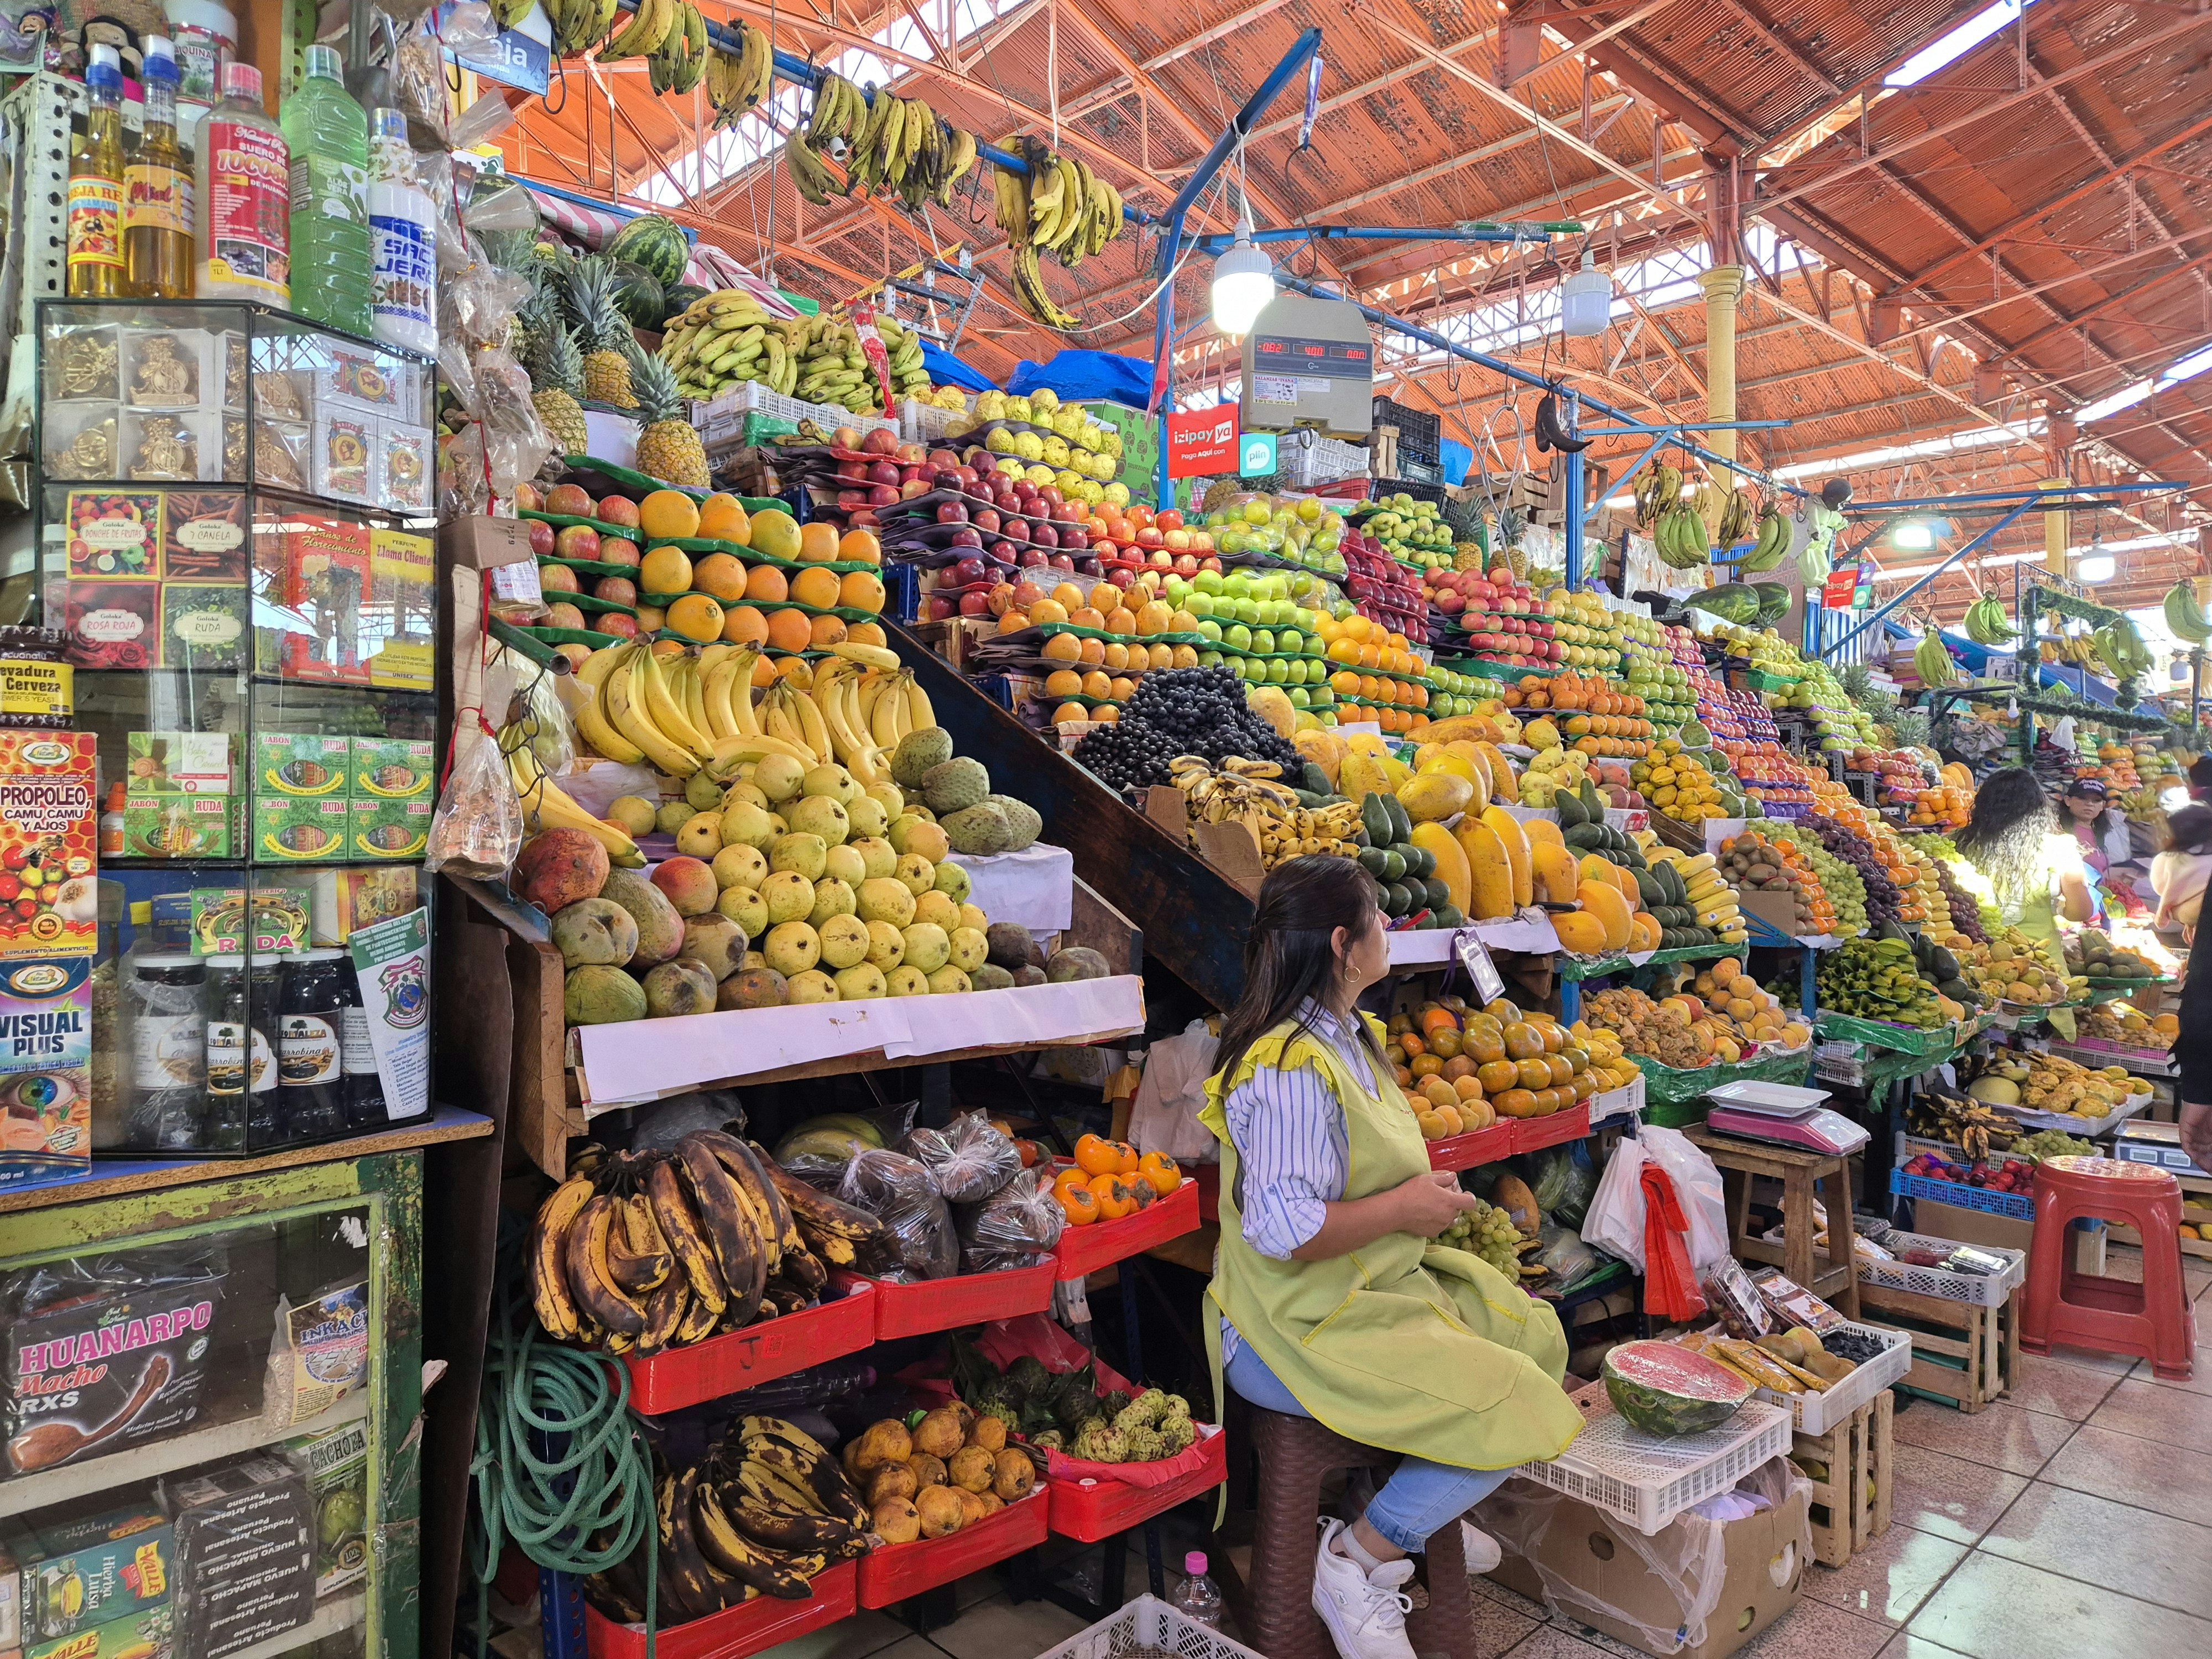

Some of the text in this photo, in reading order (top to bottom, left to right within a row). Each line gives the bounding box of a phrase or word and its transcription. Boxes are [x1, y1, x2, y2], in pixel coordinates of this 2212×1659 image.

[239, 142, 286, 166] SUERO DE
[251, 179, 261, 187] DE
[327, 177, 347, 189] ALOE
[327, 184, 347, 195] VERA
[1175, 425, 1231, 445] izipay ya
[1197, 449, 1213, 457] AQUÍ
[1249, 450, 1266, 463] plin
[112, 529, 119, 538] DE
[121, 529, 142, 538] FRUTAS
[197, 531, 230, 540] CANELA
[346, 535, 357, 543] de
[301, 535, 368, 556] Florecimiento
[393, 539, 418, 549] PERFUME
[404, 549, 431, 566] Cliente
[87, 621, 135, 630] ROSA ROJA
[195, 623, 221, 632] RUDA
[6, 677, 61, 692] Cerveza
[263, 736, 347, 751] JABÓN RUDA
[356, 740, 432, 755] JABÓN RUDA
[0, 786, 92, 809] PROPOLEO,
[129, 797, 158, 808] JABÓN
[4, 810, 83, 818] CAMU CAMU
[195, 801, 223, 812] RUDA
[322, 802, 346, 812] RUDA
[354, 801, 430, 813] JABÓN RUDA
[22, 821, 67, 831] Y AJOS
[217, 934, 294, 952] RDA
[5, 947, 48, 956] SUPLEMENTO
[0, 1011, 83, 1039] VISUAL
[14, 1035, 65, 1056] PLUS
[18, 1301, 212, 1375] HUANARPO
[14, 1364, 108, 1397] Macho
[18, 1390, 80, 1415] RXS
[309, 1429, 347, 1451] EXTRACTO DE
[227, 1491, 265, 1508] Peruano
[231, 1516, 269, 1533] Peruano
[207, 1540, 296, 1575] NUEVO MAPACHO
[103, 1555, 116, 1598] Hierba
[139, 1550, 161, 1593] VALLE
[88, 1571, 103, 1610] Luisa
[211, 1565, 299, 1601] NUEVO MAPACHO
[236, 1592, 275, 1610] Peruano
[233, 1619, 272, 1638] Peruano
